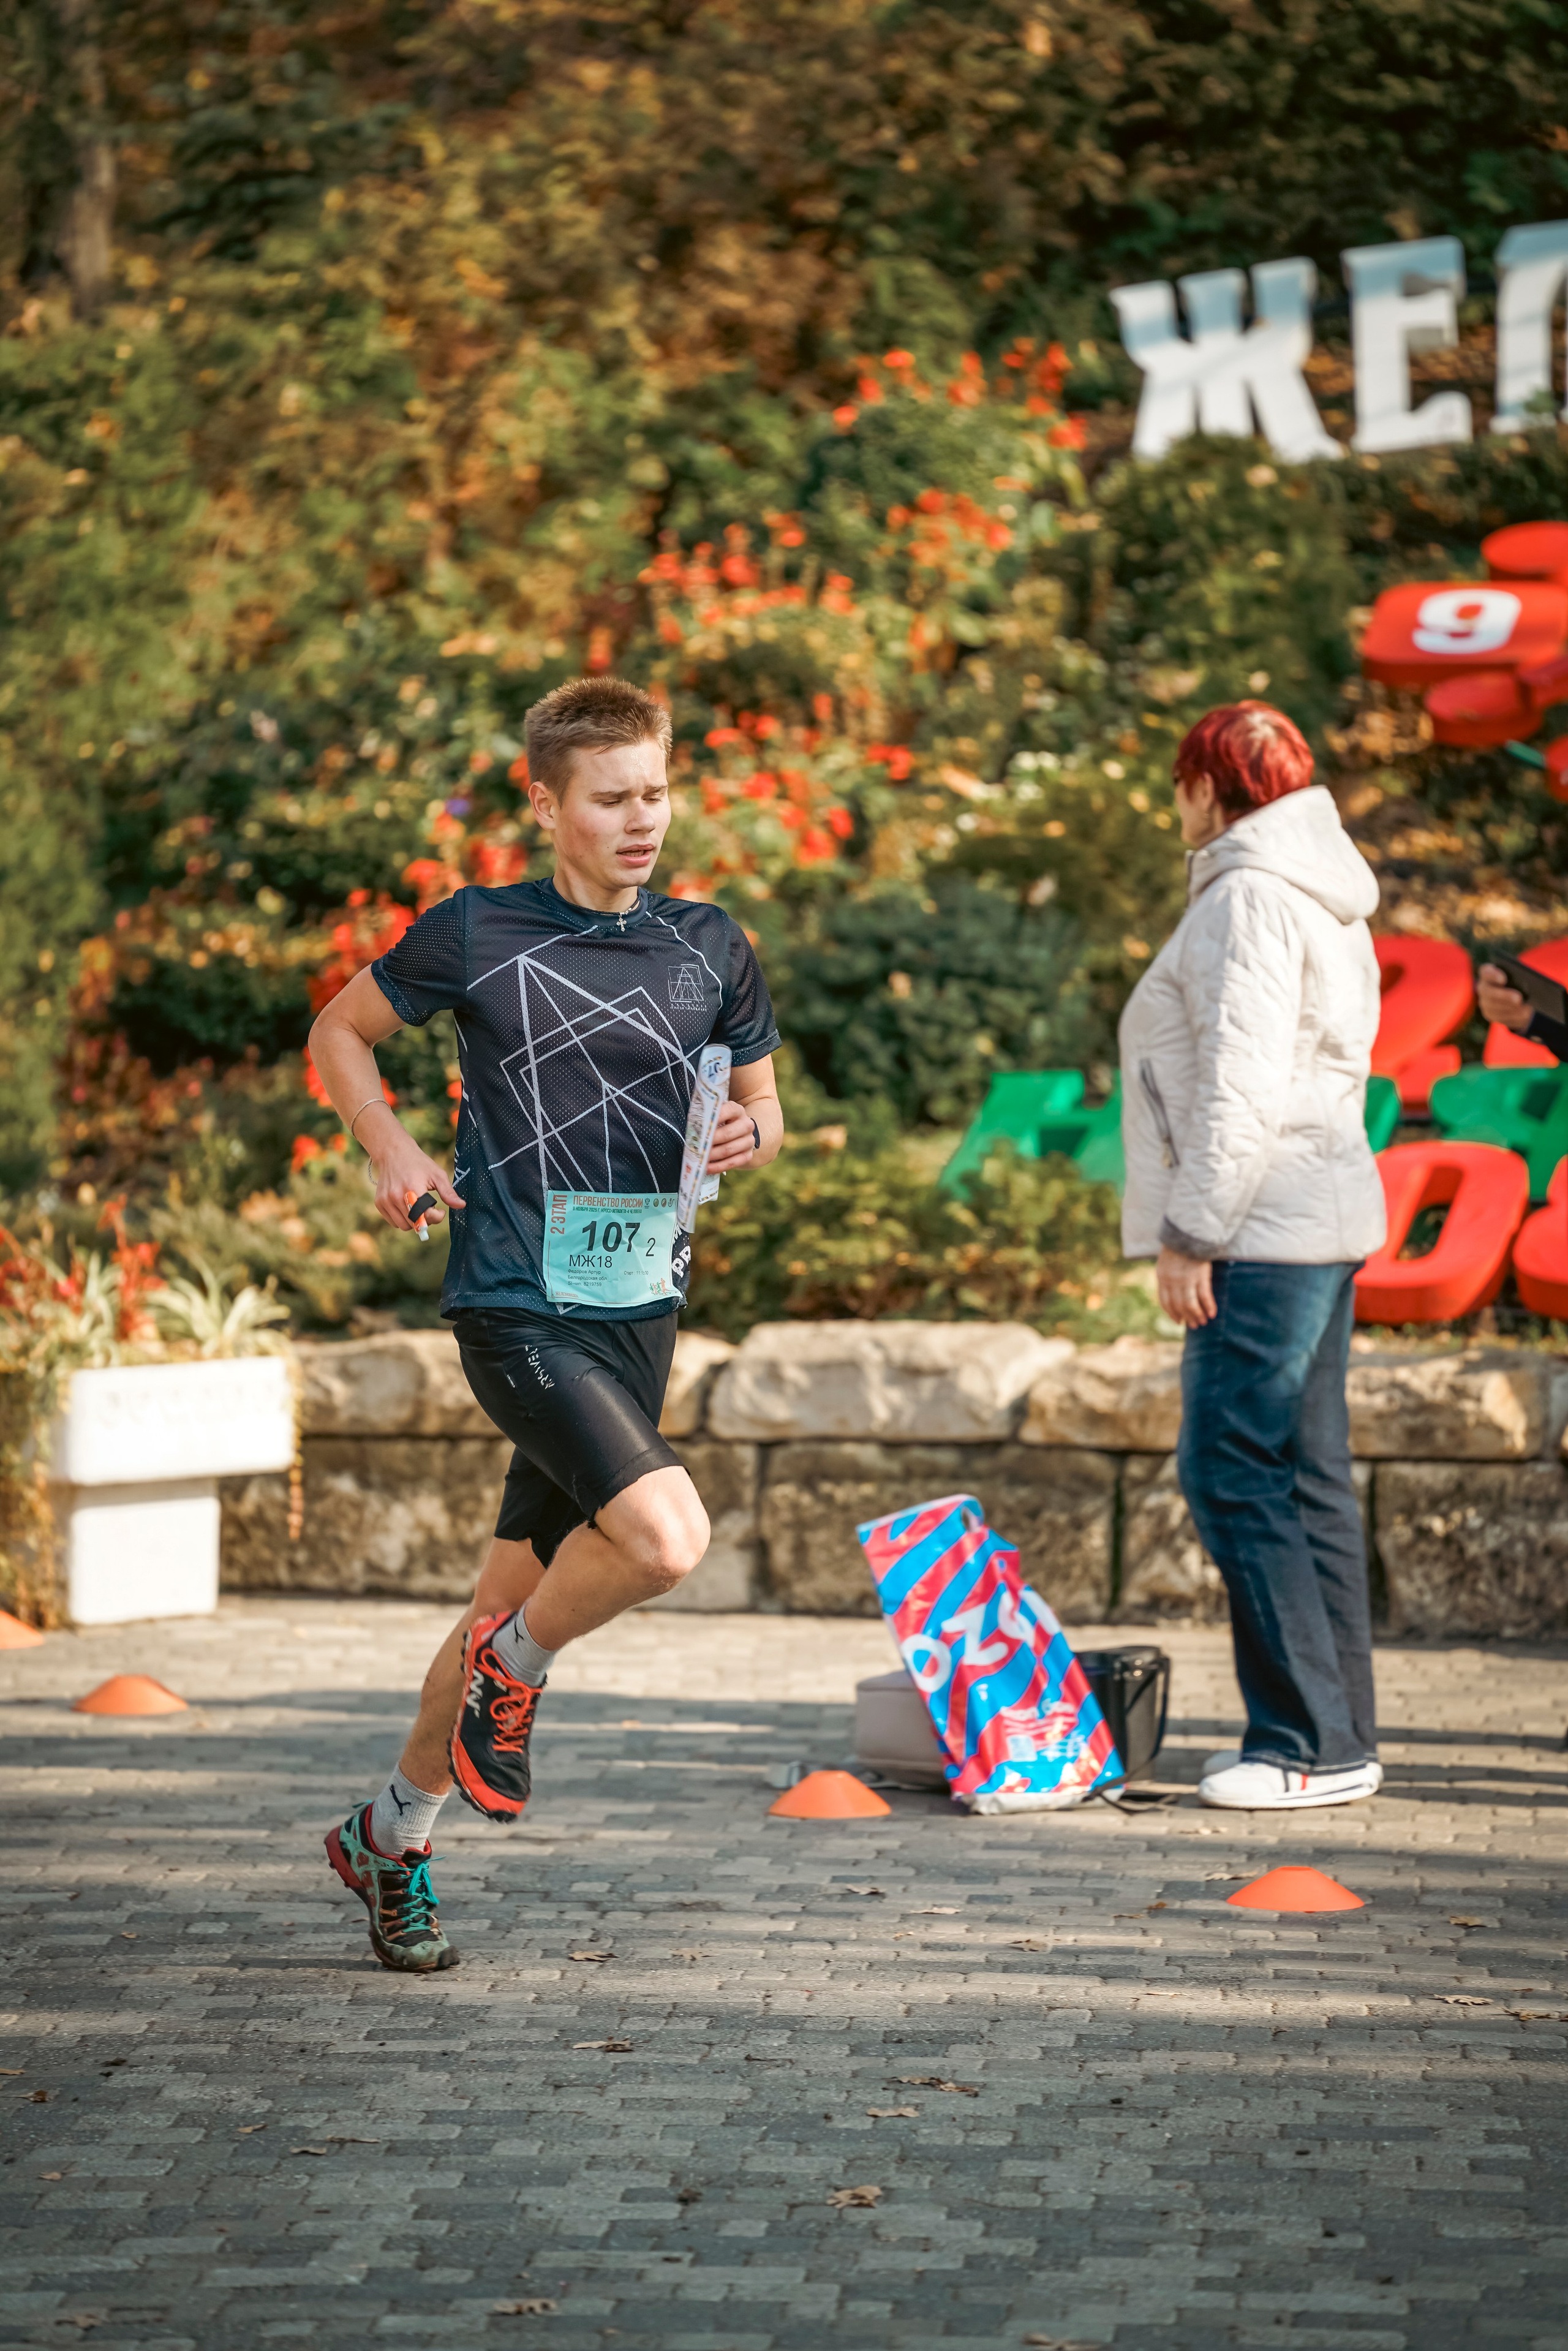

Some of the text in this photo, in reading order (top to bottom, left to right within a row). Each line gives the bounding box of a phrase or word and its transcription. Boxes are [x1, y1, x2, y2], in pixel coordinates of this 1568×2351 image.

[1412, 589, 1522, 654] 9
[550, 1194, 567, 1235] 2 ЭТАП
[573, 1195, 643, 1208] ПЕРВЕНСТВО РОССИИ
[582, 1220, 641, 1253] 107
[645, 1237, 656, 1257] 2
[568, 1254, 612, 1268] МЖ18
